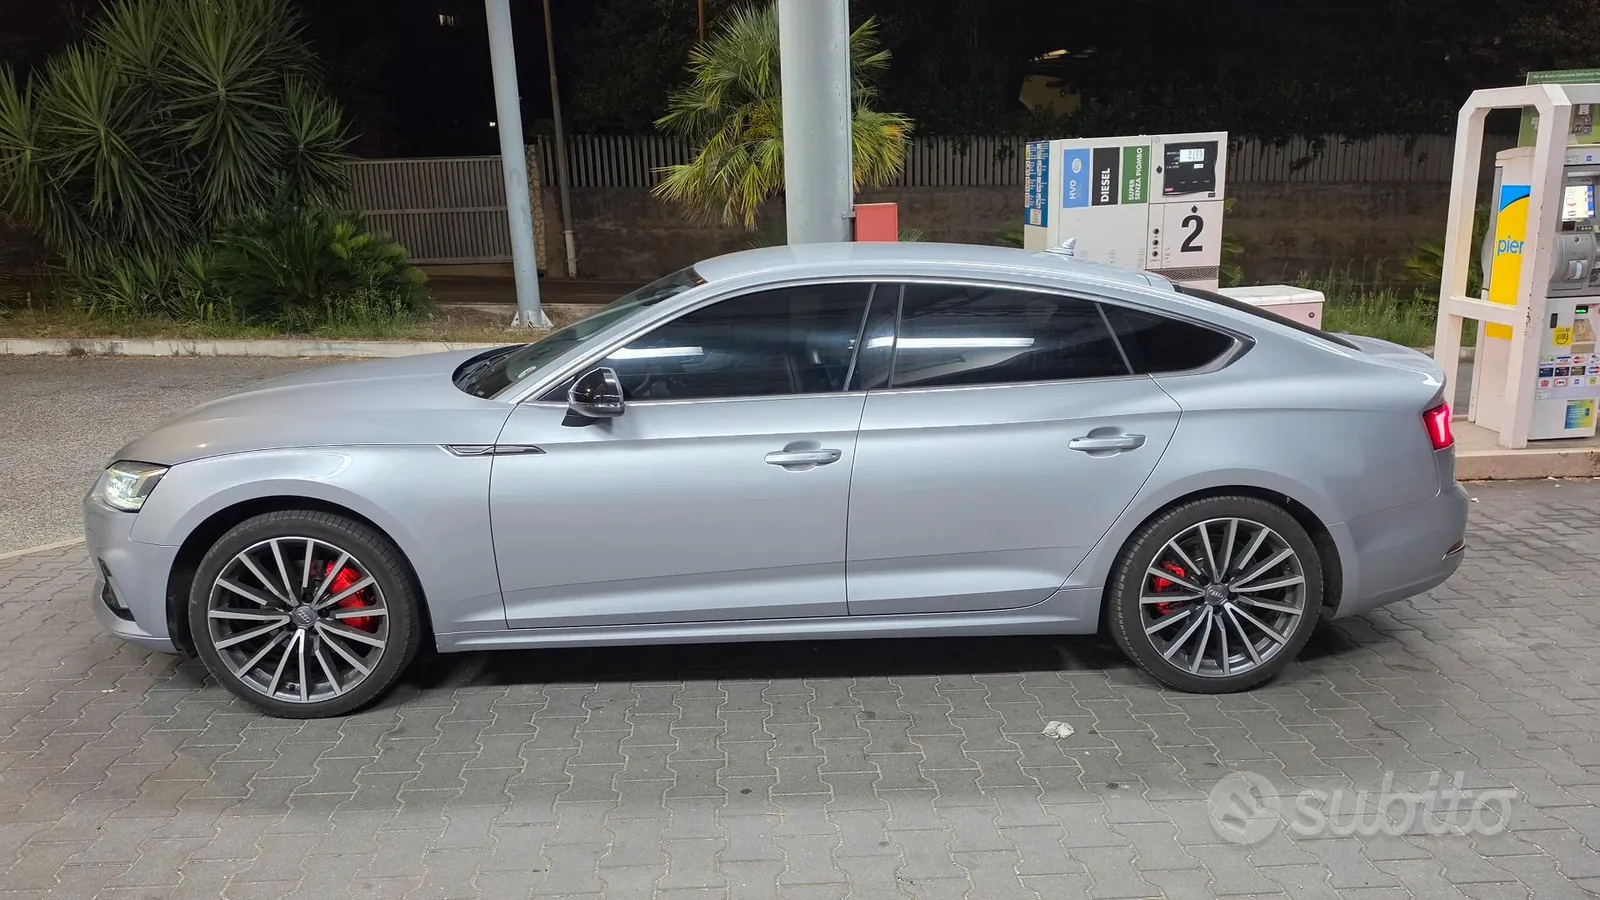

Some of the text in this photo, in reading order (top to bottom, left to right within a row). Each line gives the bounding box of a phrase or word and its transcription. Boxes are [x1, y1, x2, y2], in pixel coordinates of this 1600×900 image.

[1135, 147, 1143, 177] PIOMBO
[1069, 179, 1077, 200] HVO
[1100, 167, 1111, 203] DIESEL
[1128, 179, 1136, 201] SUPER
[1180, 214, 1204, 253] 2
